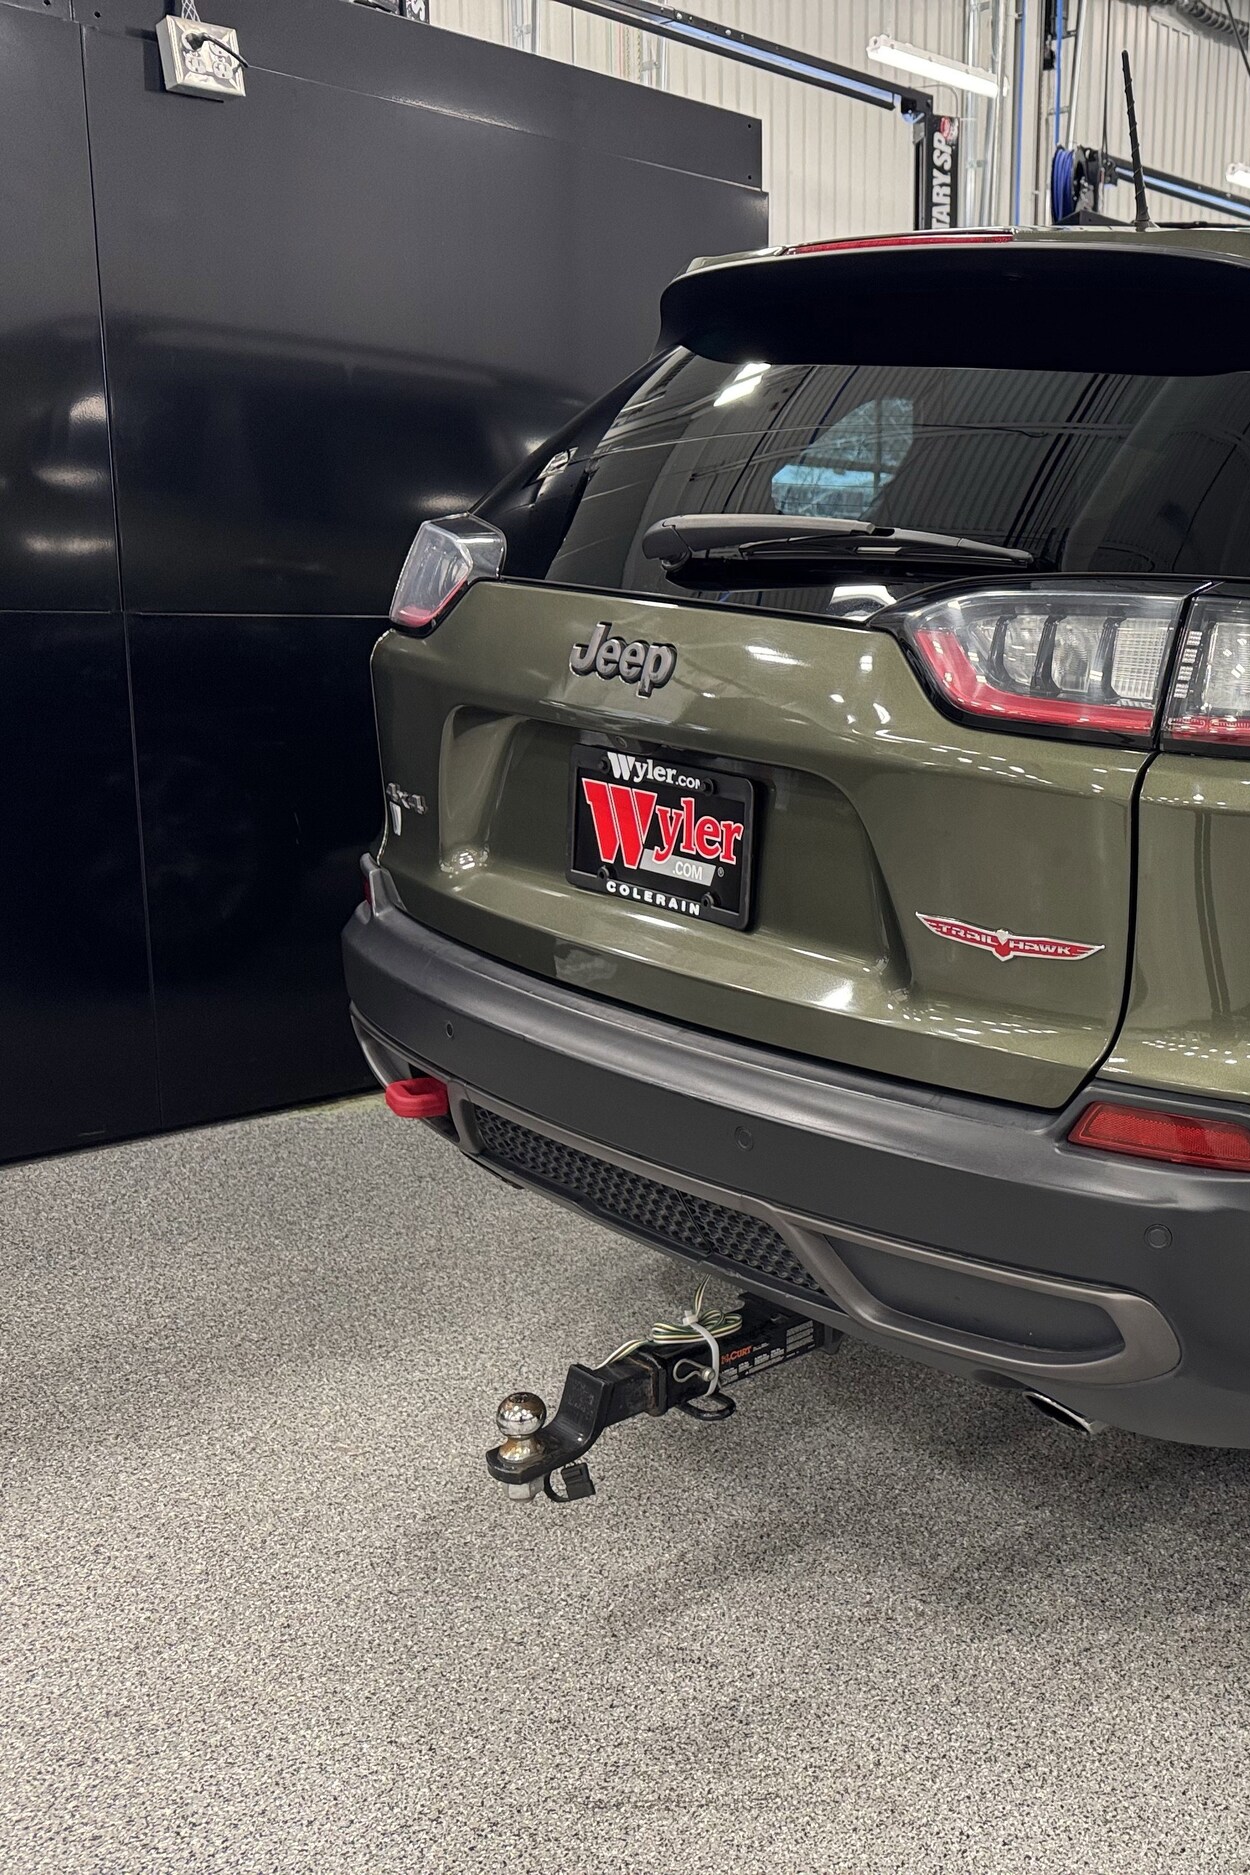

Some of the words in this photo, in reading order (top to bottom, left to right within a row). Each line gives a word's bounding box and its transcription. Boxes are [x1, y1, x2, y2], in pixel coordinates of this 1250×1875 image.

[569, 621, 677, 698] Jeep
[582, 777, 744, 870] Wyler
[672, 860, 703, 881] .COM
[606, 881, 700, 916] COLERAIN
[939, 923, 999, 946] TRAIL
[1009, 939, 1071, 955] HAWK
[730, 1345, 753, 1361] CURT
